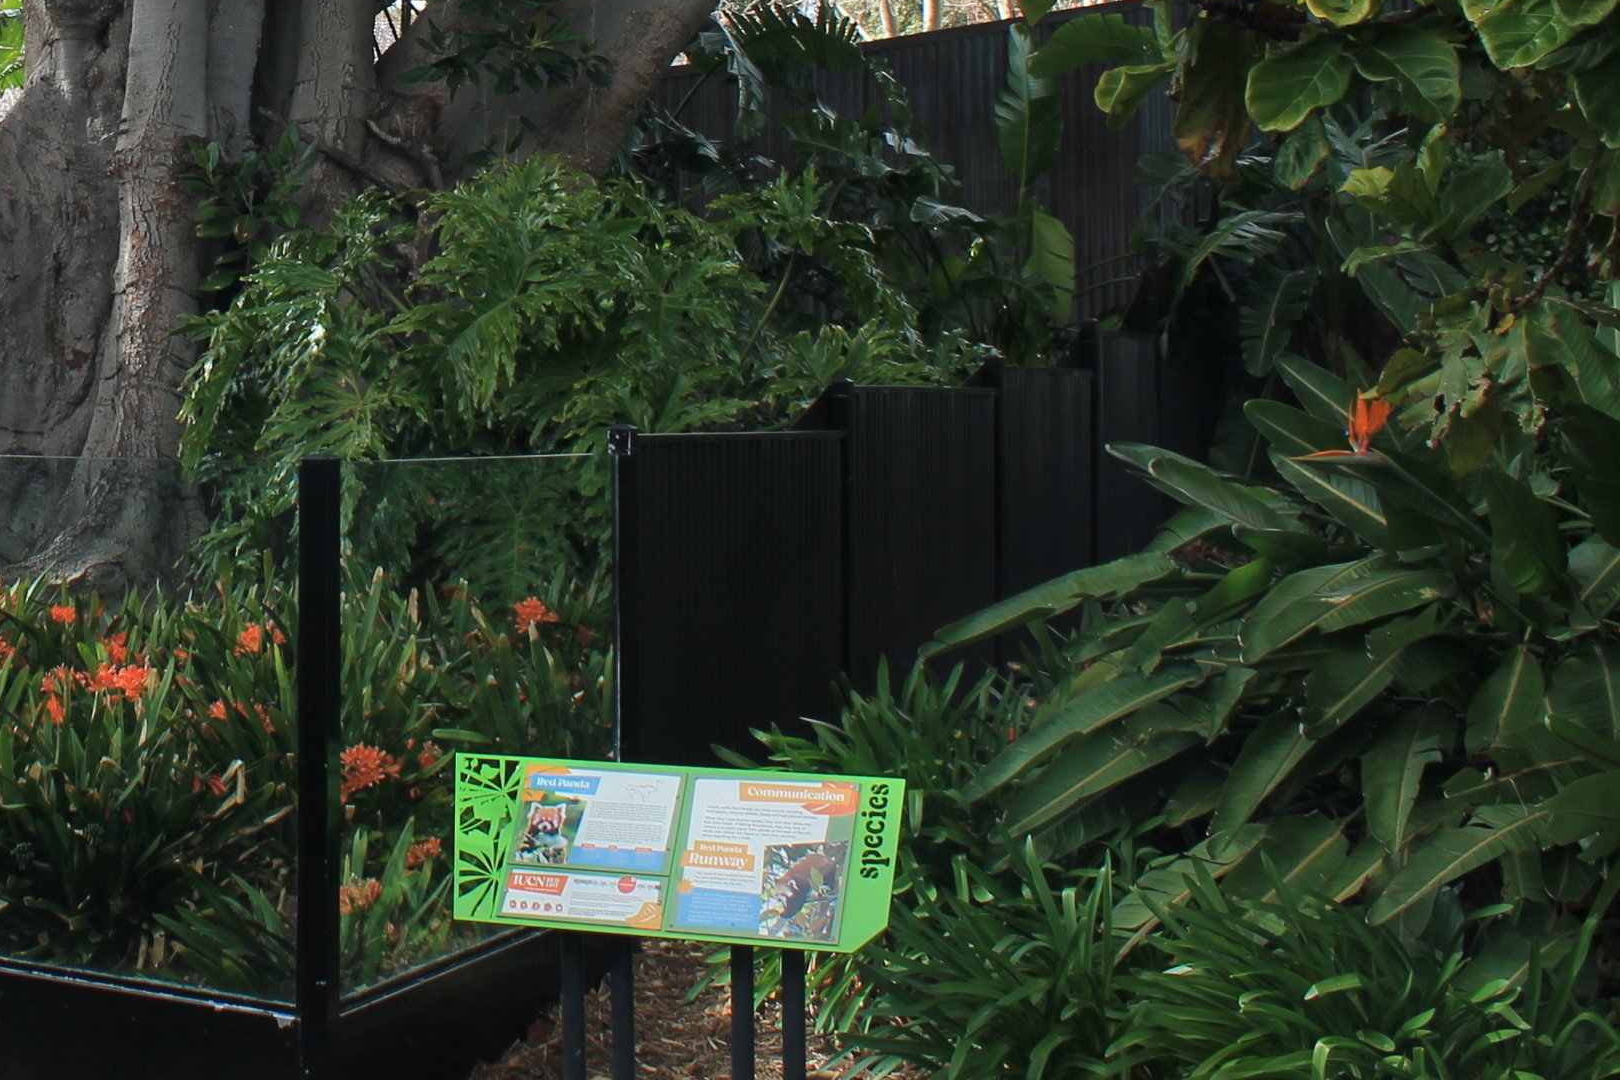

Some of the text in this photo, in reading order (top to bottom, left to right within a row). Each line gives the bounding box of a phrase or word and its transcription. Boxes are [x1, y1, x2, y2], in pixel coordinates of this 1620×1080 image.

[536, 777, 591, 789] Red Panda
[747, 786, 845, 802] Communication
[860, 784, 890, 879] species
[699, 843, 742, 854] Red Panda
[689, 852, 749, 870] Runway
[513, 874, 546, 887] IUCN
